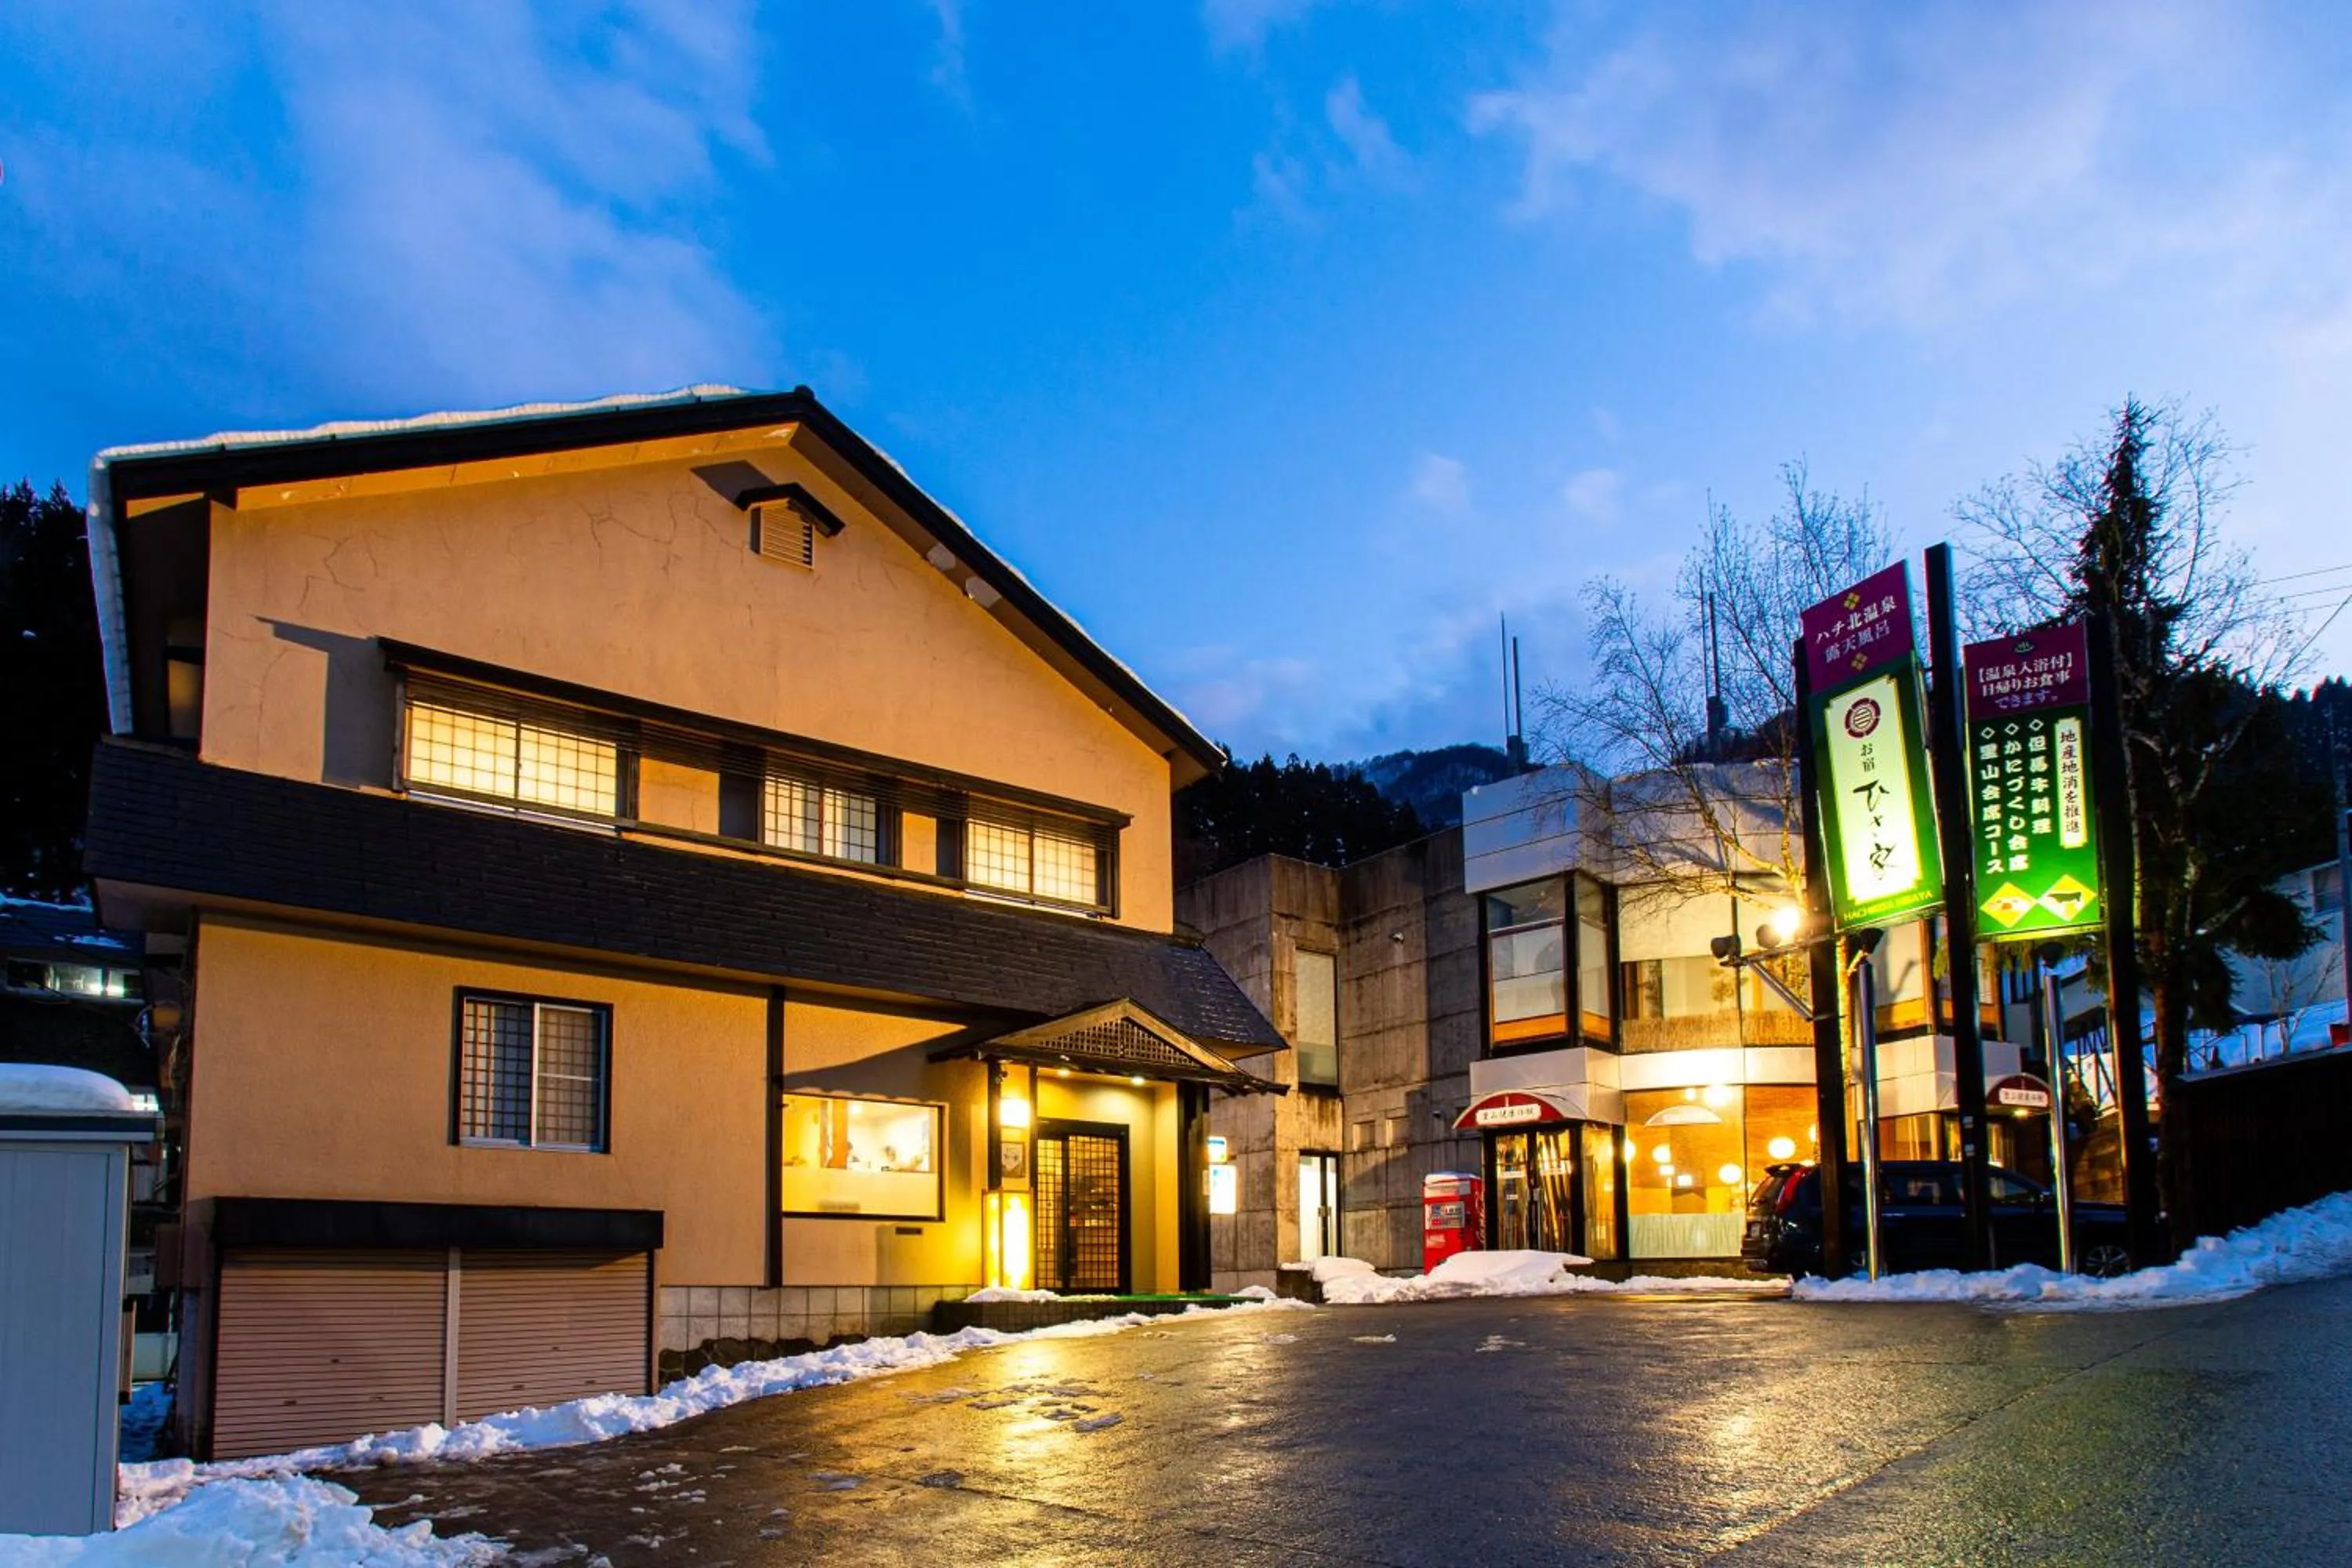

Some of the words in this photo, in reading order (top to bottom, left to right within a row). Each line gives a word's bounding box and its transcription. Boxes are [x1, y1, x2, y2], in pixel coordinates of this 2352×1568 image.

[1816, 595, 1896, 644] ハチ北温泉
